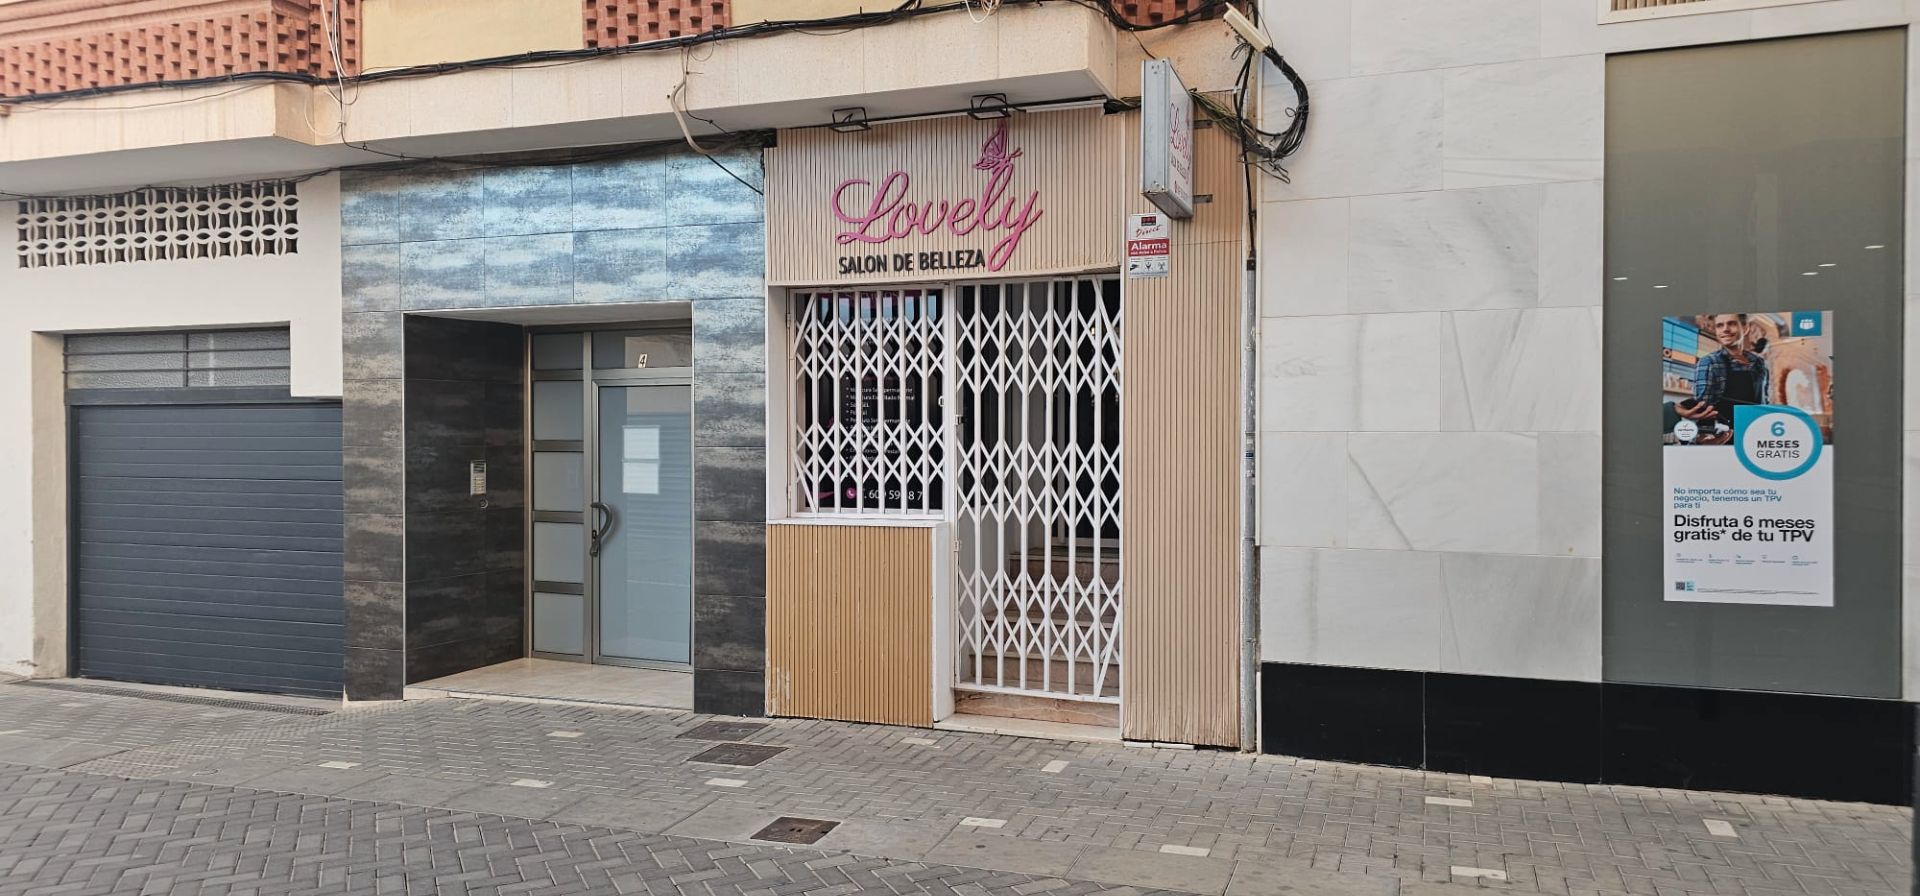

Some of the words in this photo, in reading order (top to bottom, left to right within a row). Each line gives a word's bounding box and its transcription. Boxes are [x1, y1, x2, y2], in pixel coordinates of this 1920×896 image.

[832, 163, 1043, 272] Lovely
[1131, 242, 1167, 251] Alarma
[838, 254, 888, 275] SALON
[893, 253, 914, 273] DE
[918, 249, 986, 272] BELLEZA
[639, 354, 646, 367] 4
[1770, 421, 1785, 437] 6
[1756, 440, 1800, 448] MESES
[1756, 449, 1800, 459] GRATIS
[1673, 487, 1686, 495] No
[1688, 488, 1721, 496] importa
[1673, 495, 1710, 503] negocio,
[1674, 514, 1739, 528] Disfruta
[1743, 515, 1754, 528] 6
[1758, 518, 1815, 529] meses
[1731, 529, 1753, 541] de
[1757, 530, 1774, 542] tu
[1779, 530, 1814, 542] TPV
